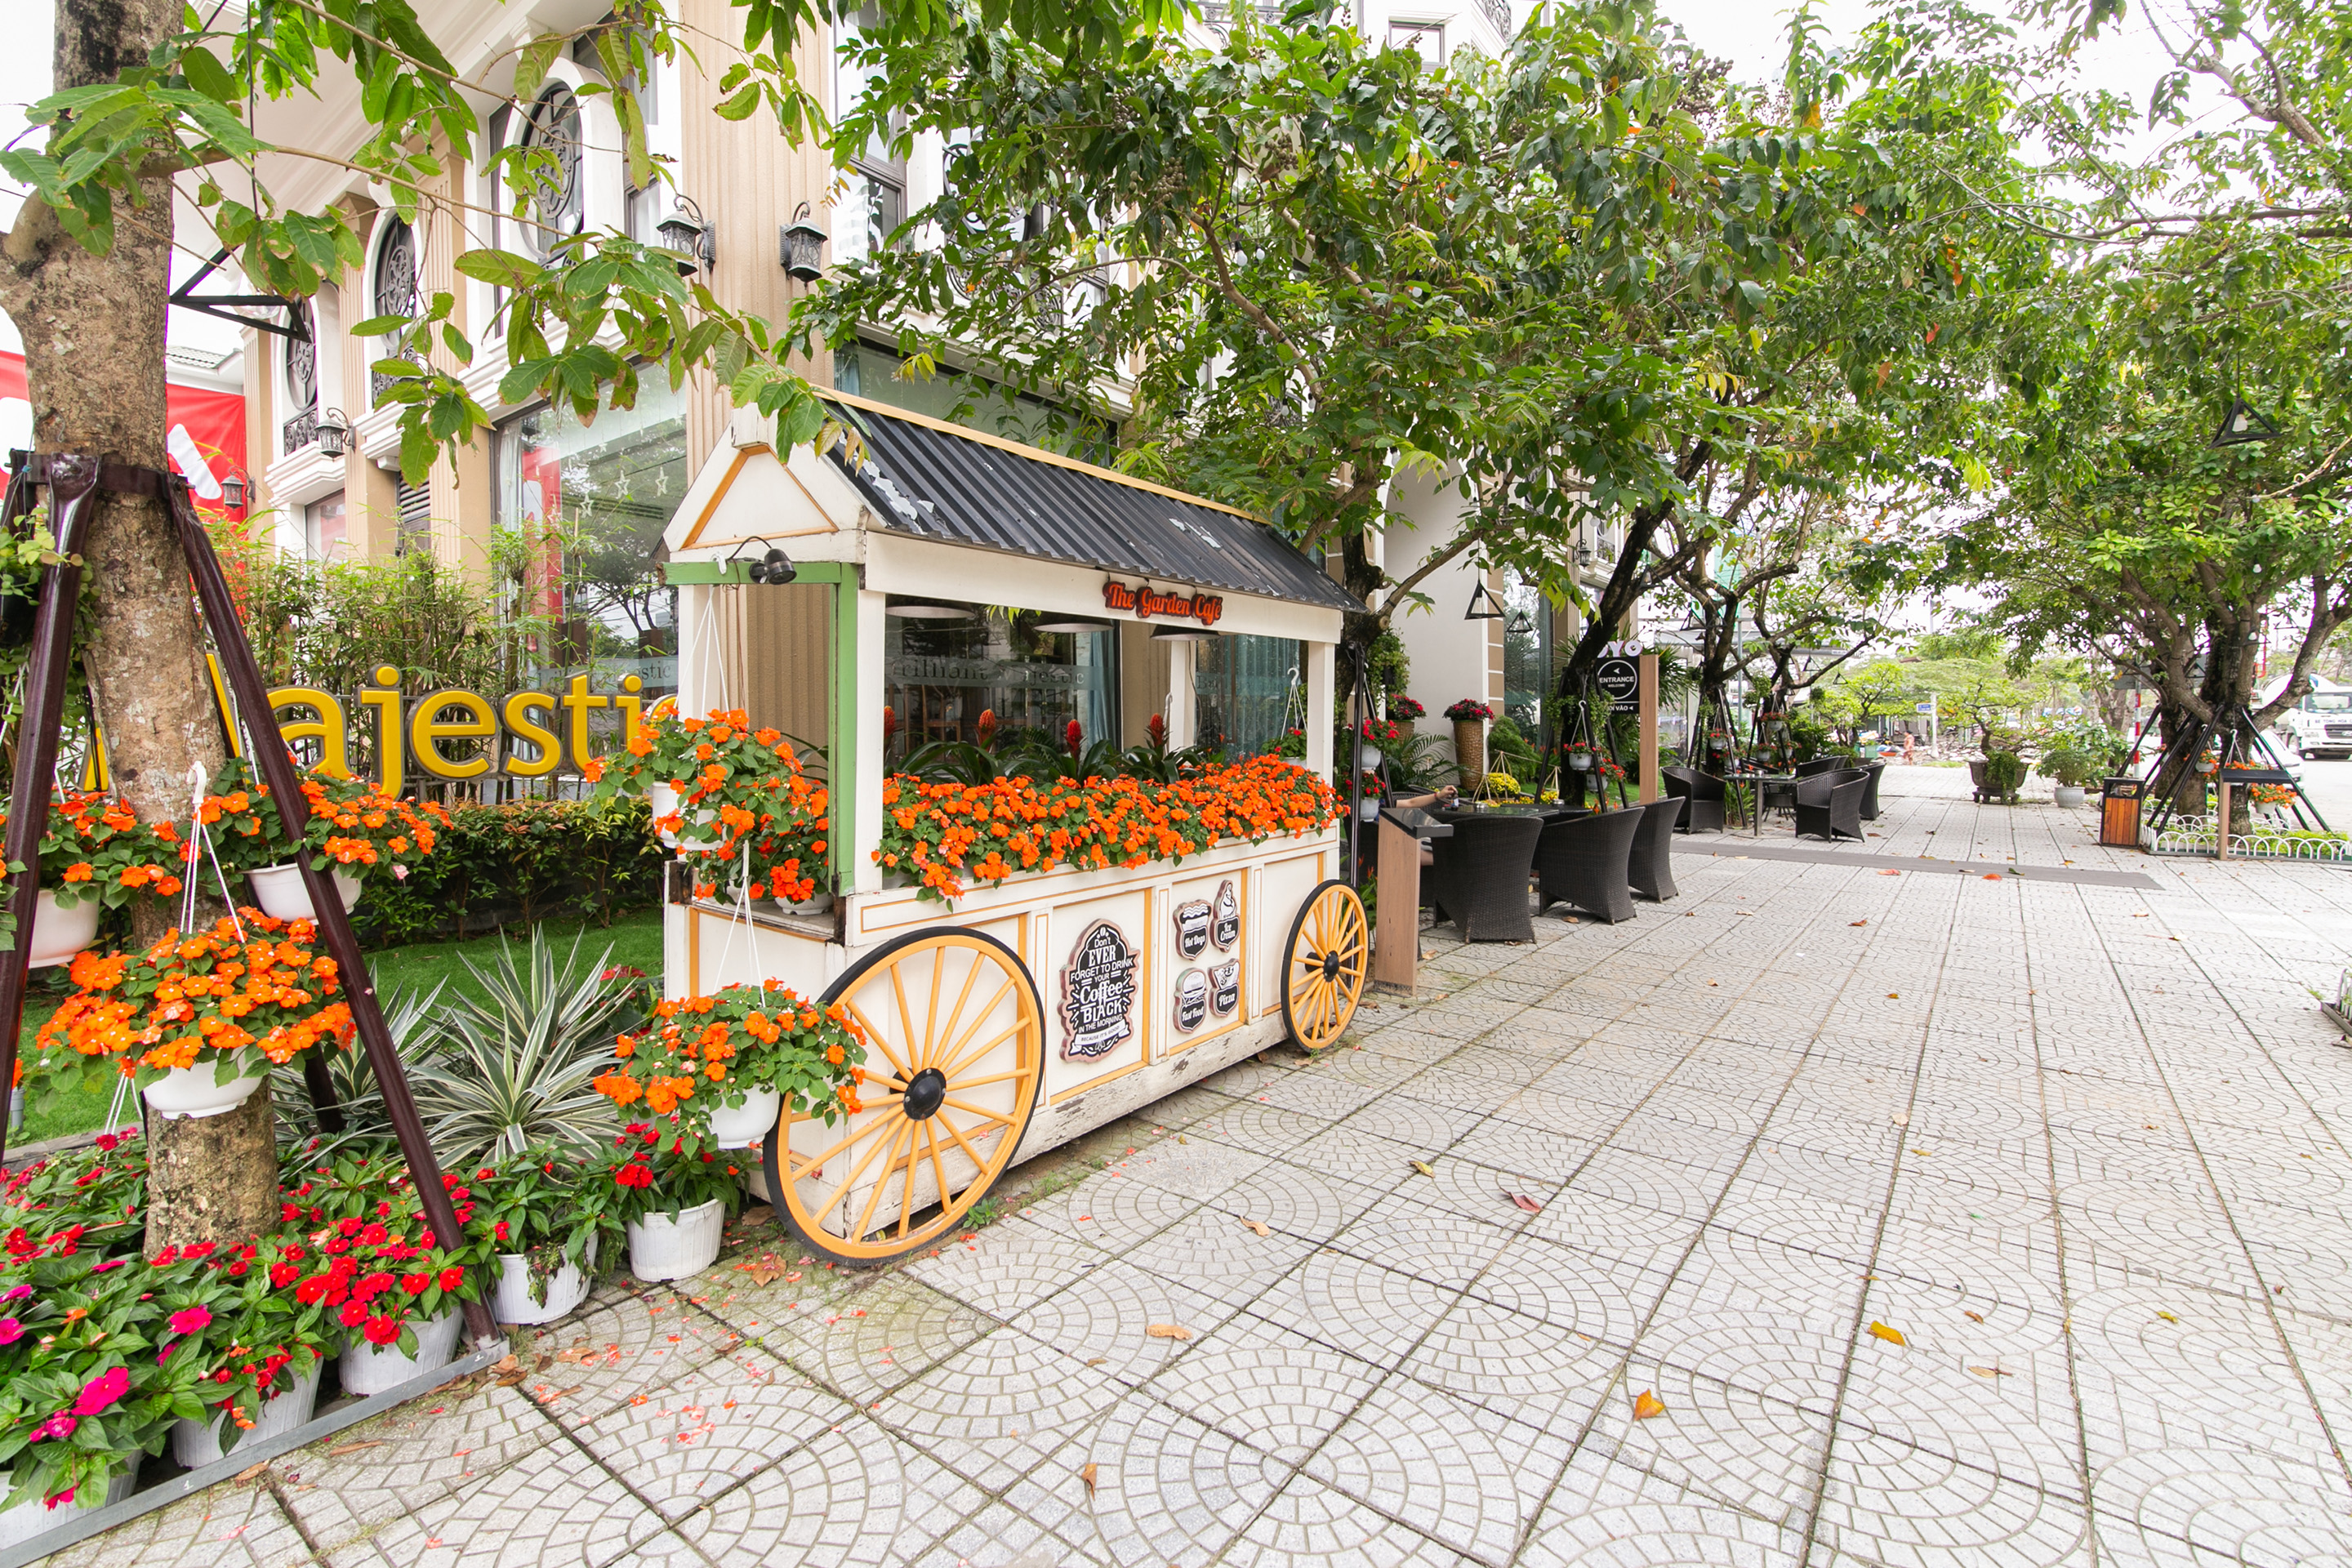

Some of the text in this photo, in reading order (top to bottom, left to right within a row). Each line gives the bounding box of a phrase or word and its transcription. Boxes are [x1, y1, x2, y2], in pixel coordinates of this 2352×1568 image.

[1109, 584, 1223, 625] The Garden Café
[1599, 675, 1635, 684] ENTRANCE
[1223, 922, 1232, 932] Ice
[1094, 937, 1111, 948] Don't
[1184, 933, 1205, 948] Hot Dogs
[1220, 929, 1236, 942] Cream
[1088, 945, 1117, 967] EVER
[1070, 957, 1134, 982] FORGET TO DRINK
[1094, 973, 1110, 983] YOUR
[1080, 979, 1124, 1006] Coffee
[1218, 992, 1235, 1007] Pizza
[1081, 1000, 1122, 1023] BLACK
[1182, 1006, 1204, 1022] Fast Food
[1078, 1013, 1124, 1034] IN THE MORNING
[1108, 1025, 1120, 1034] GOOD
